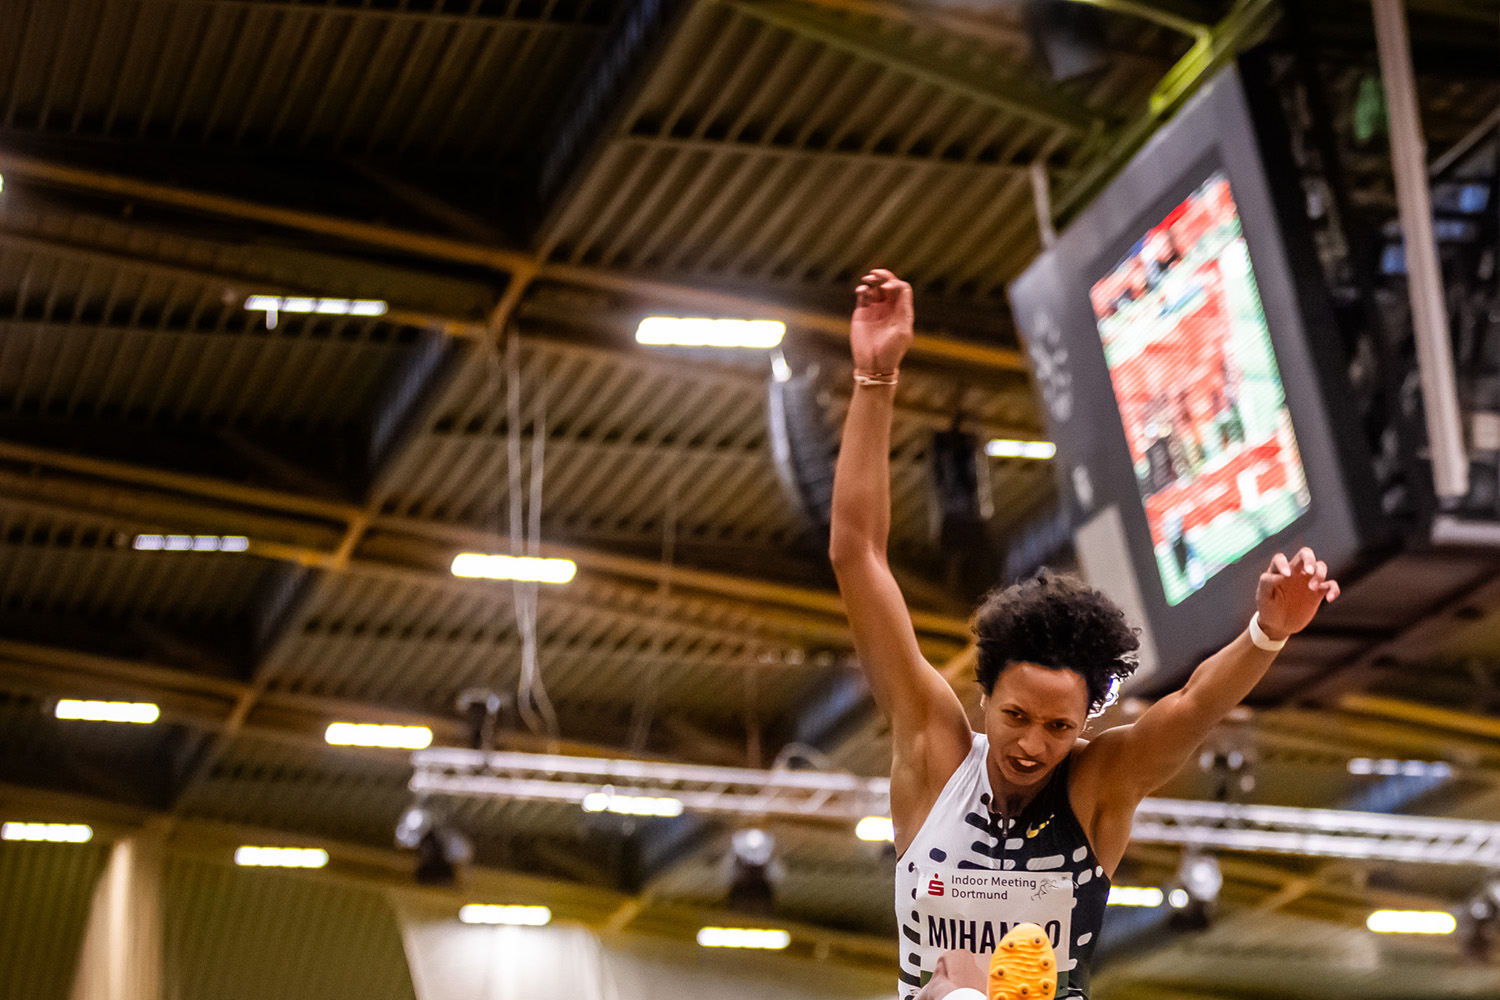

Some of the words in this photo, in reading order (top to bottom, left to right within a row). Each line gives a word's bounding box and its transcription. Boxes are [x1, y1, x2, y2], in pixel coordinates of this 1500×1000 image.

[951, 875, 988, 885] Indoor
[991, 876, 1037, 889] Meeting
[951, 888, 1008, 900] Dortmund
